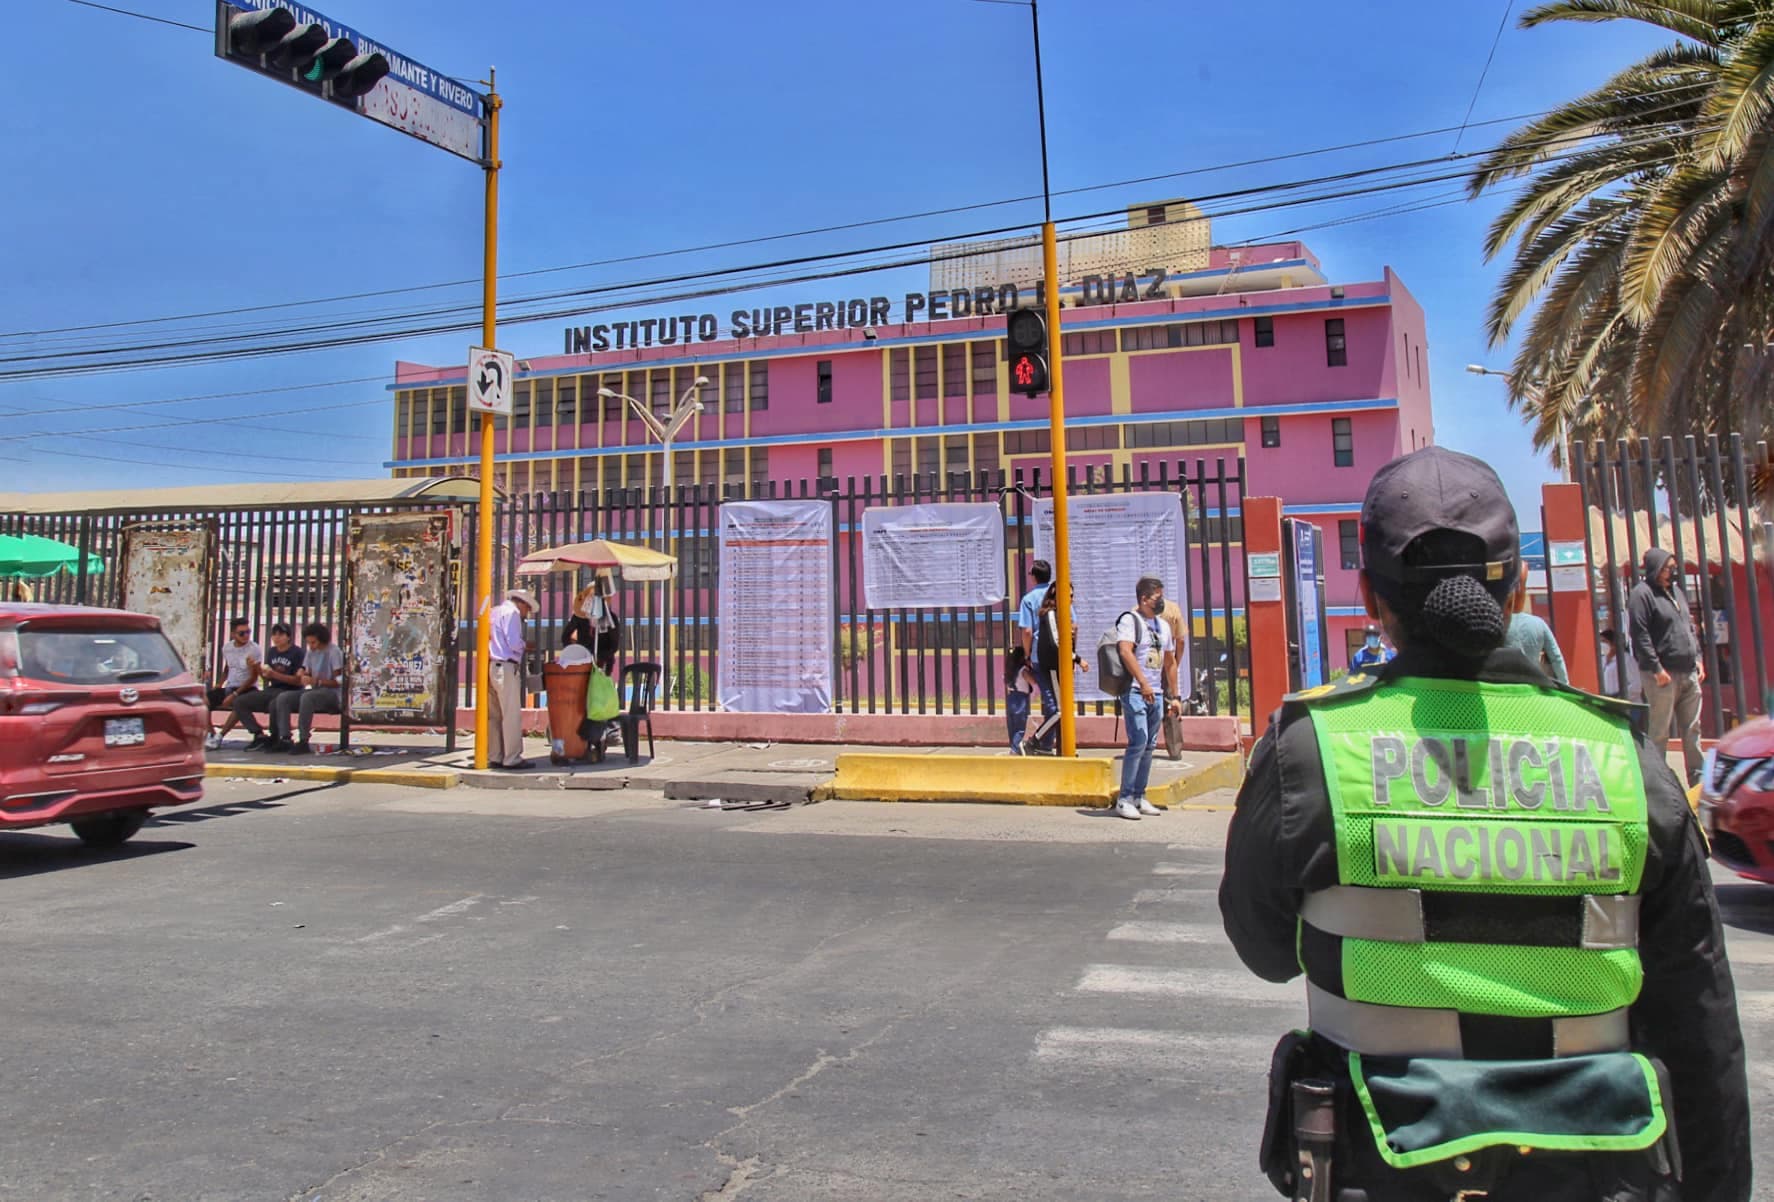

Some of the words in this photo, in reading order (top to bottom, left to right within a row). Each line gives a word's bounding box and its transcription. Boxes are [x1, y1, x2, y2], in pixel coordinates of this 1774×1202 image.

[430, 72, 437, 92] Y
[439, 77, 473, 110] RIVERO
[564, 313, 718, 355] INSTITUTO
[730, 296, 890, 339] SUPERIOR
[905, 283, 1018, 322] PEDRO
[1082, 268, 1167, 304] DIAZ
[1376, 824, 1621, 882] NACIONAL
